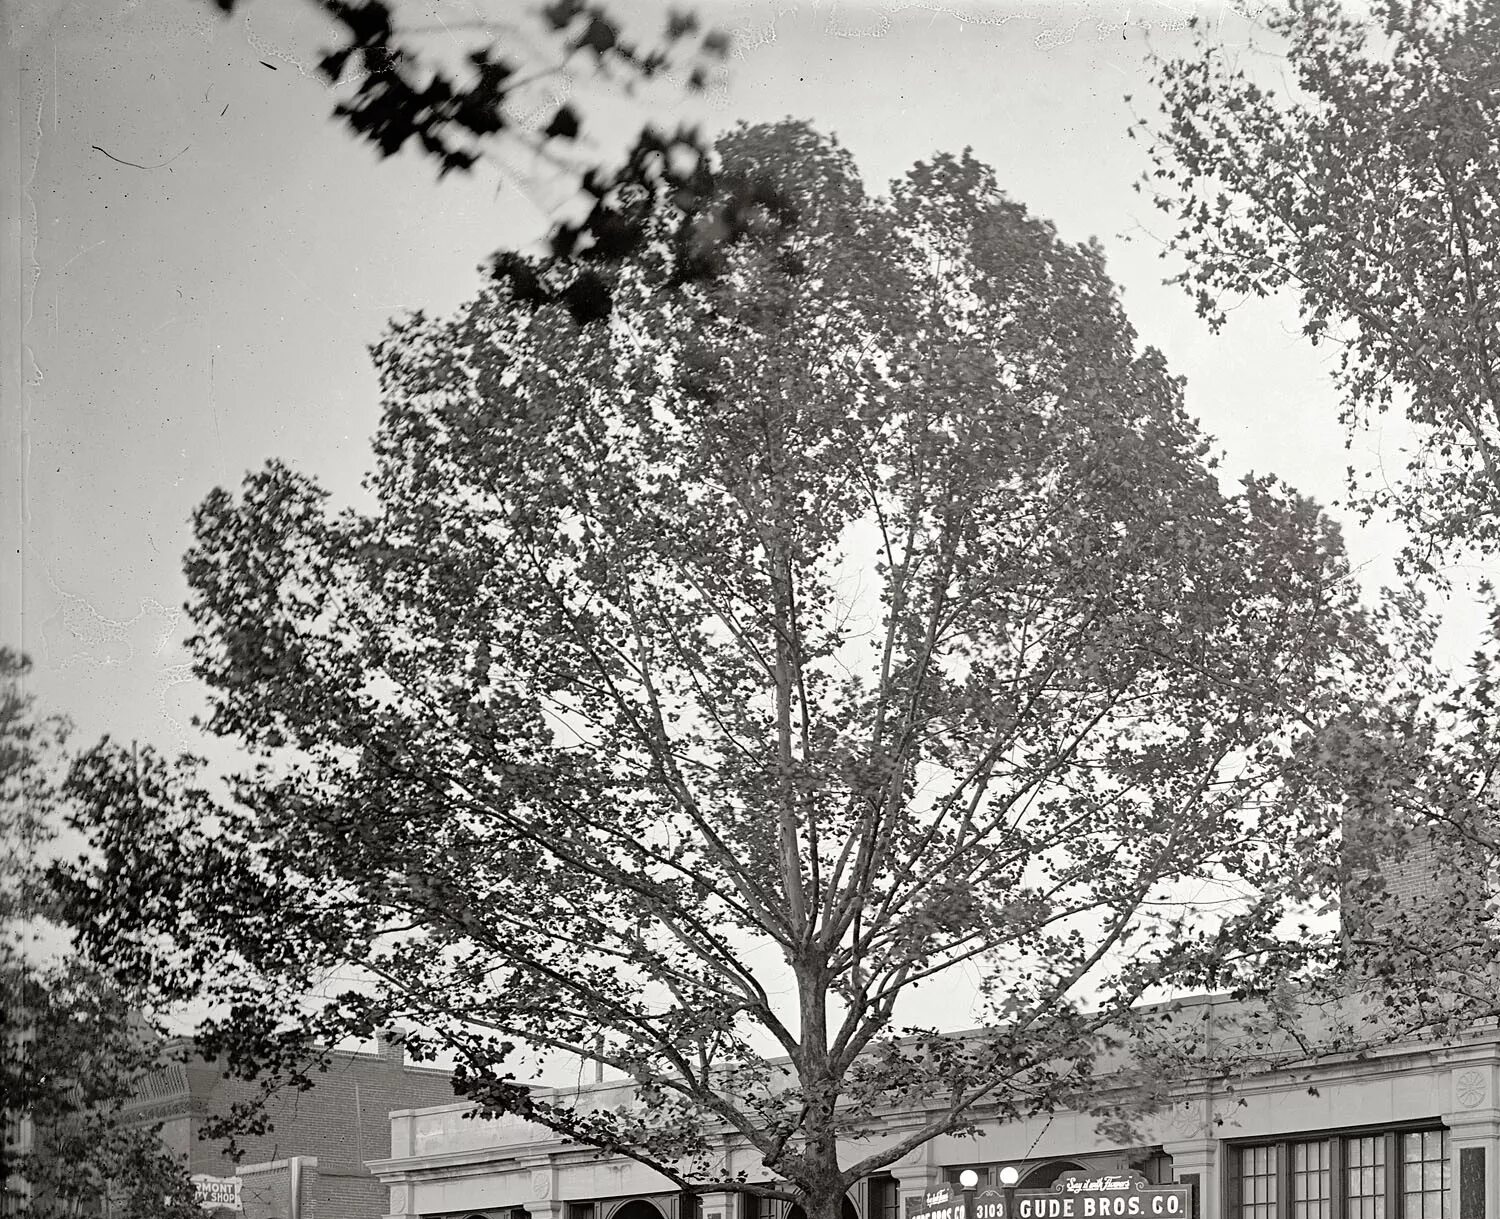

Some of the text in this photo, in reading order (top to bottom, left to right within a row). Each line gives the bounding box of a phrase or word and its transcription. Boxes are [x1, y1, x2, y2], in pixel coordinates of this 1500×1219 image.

[211, 1193, 235, 1203] SHOP
[976, 1203, 1003, 1219] 3103
[1020, 1195, 1184, 1219] GUDE BROS. CO.
